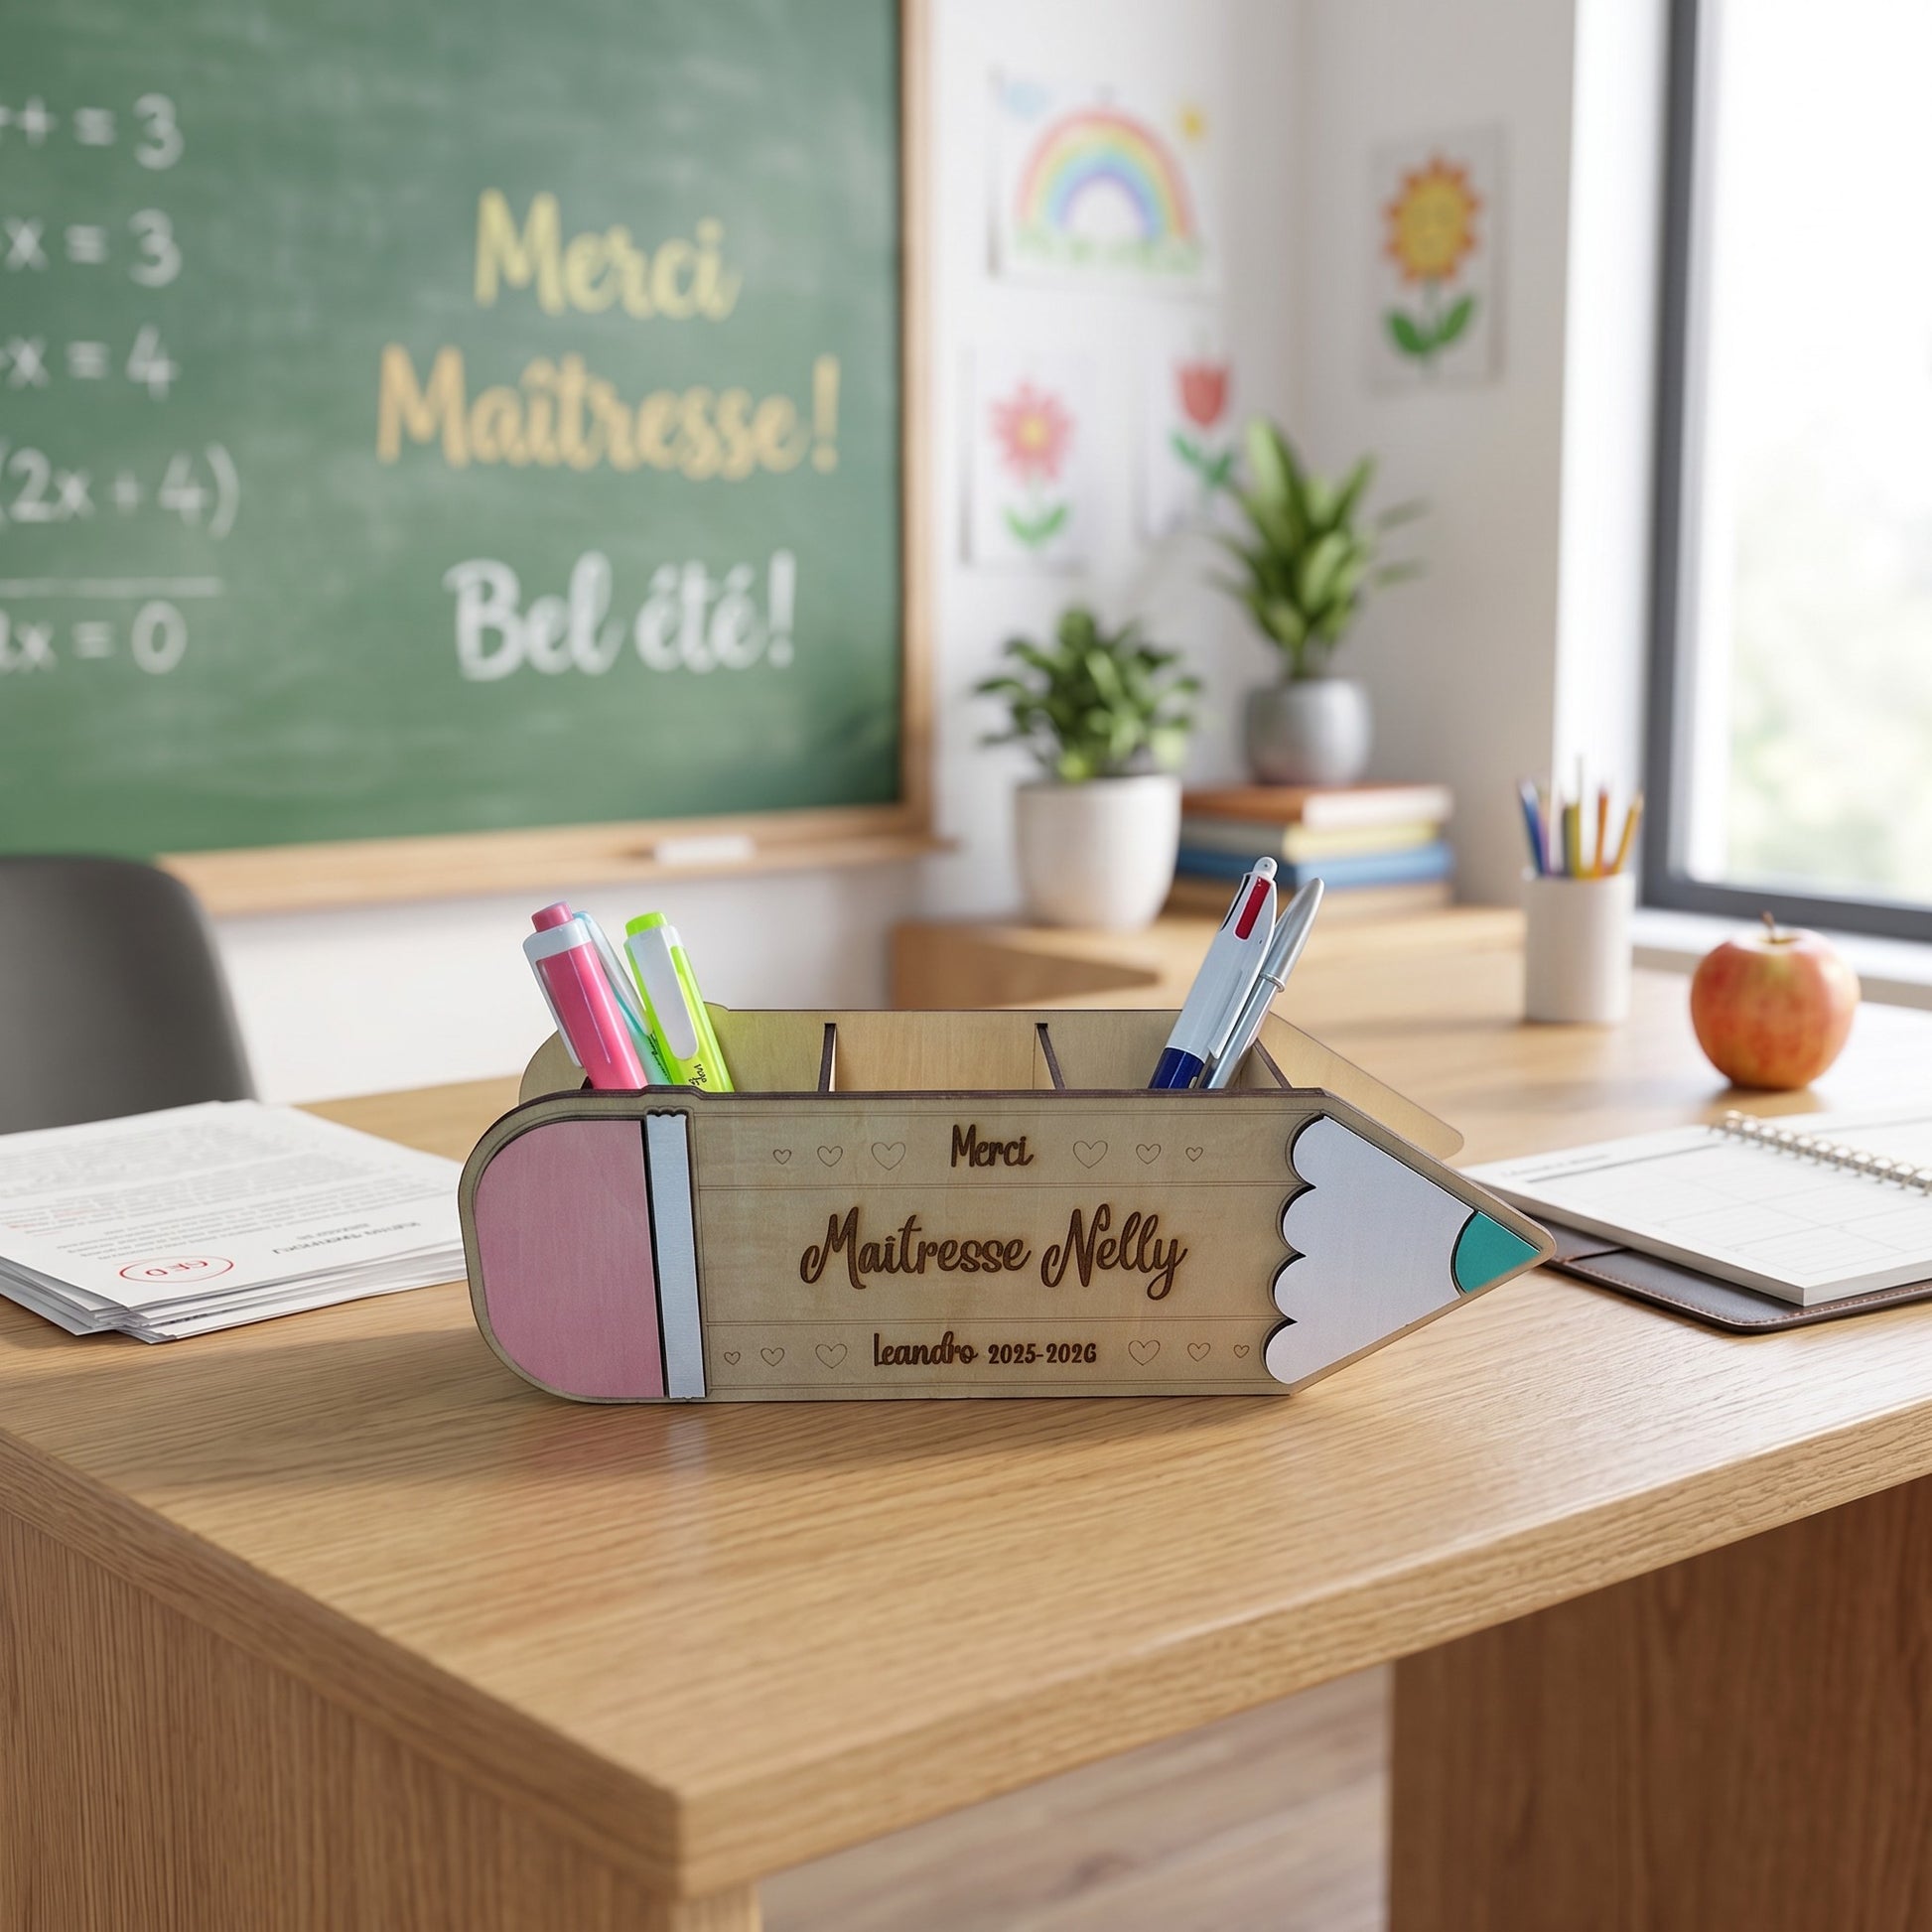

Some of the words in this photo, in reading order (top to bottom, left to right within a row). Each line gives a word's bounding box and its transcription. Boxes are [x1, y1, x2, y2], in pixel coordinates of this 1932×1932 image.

[133, 92, 185, 170] 3
[127, 207, 182, 287] 3
[475, 189, 742, 321] Merci
[126, 324, 179, 399] 4
[376, 343, 840, 482] Maîtresse!
[443, 550, 626, 682] Bel
[634, 548, 796, 673] été!
[950, 1124, 1035, 1168] Merci
[1040, 1203, 1188, 1301] Nelly
[988, 1342, 1097, 1364] 2025-2026
